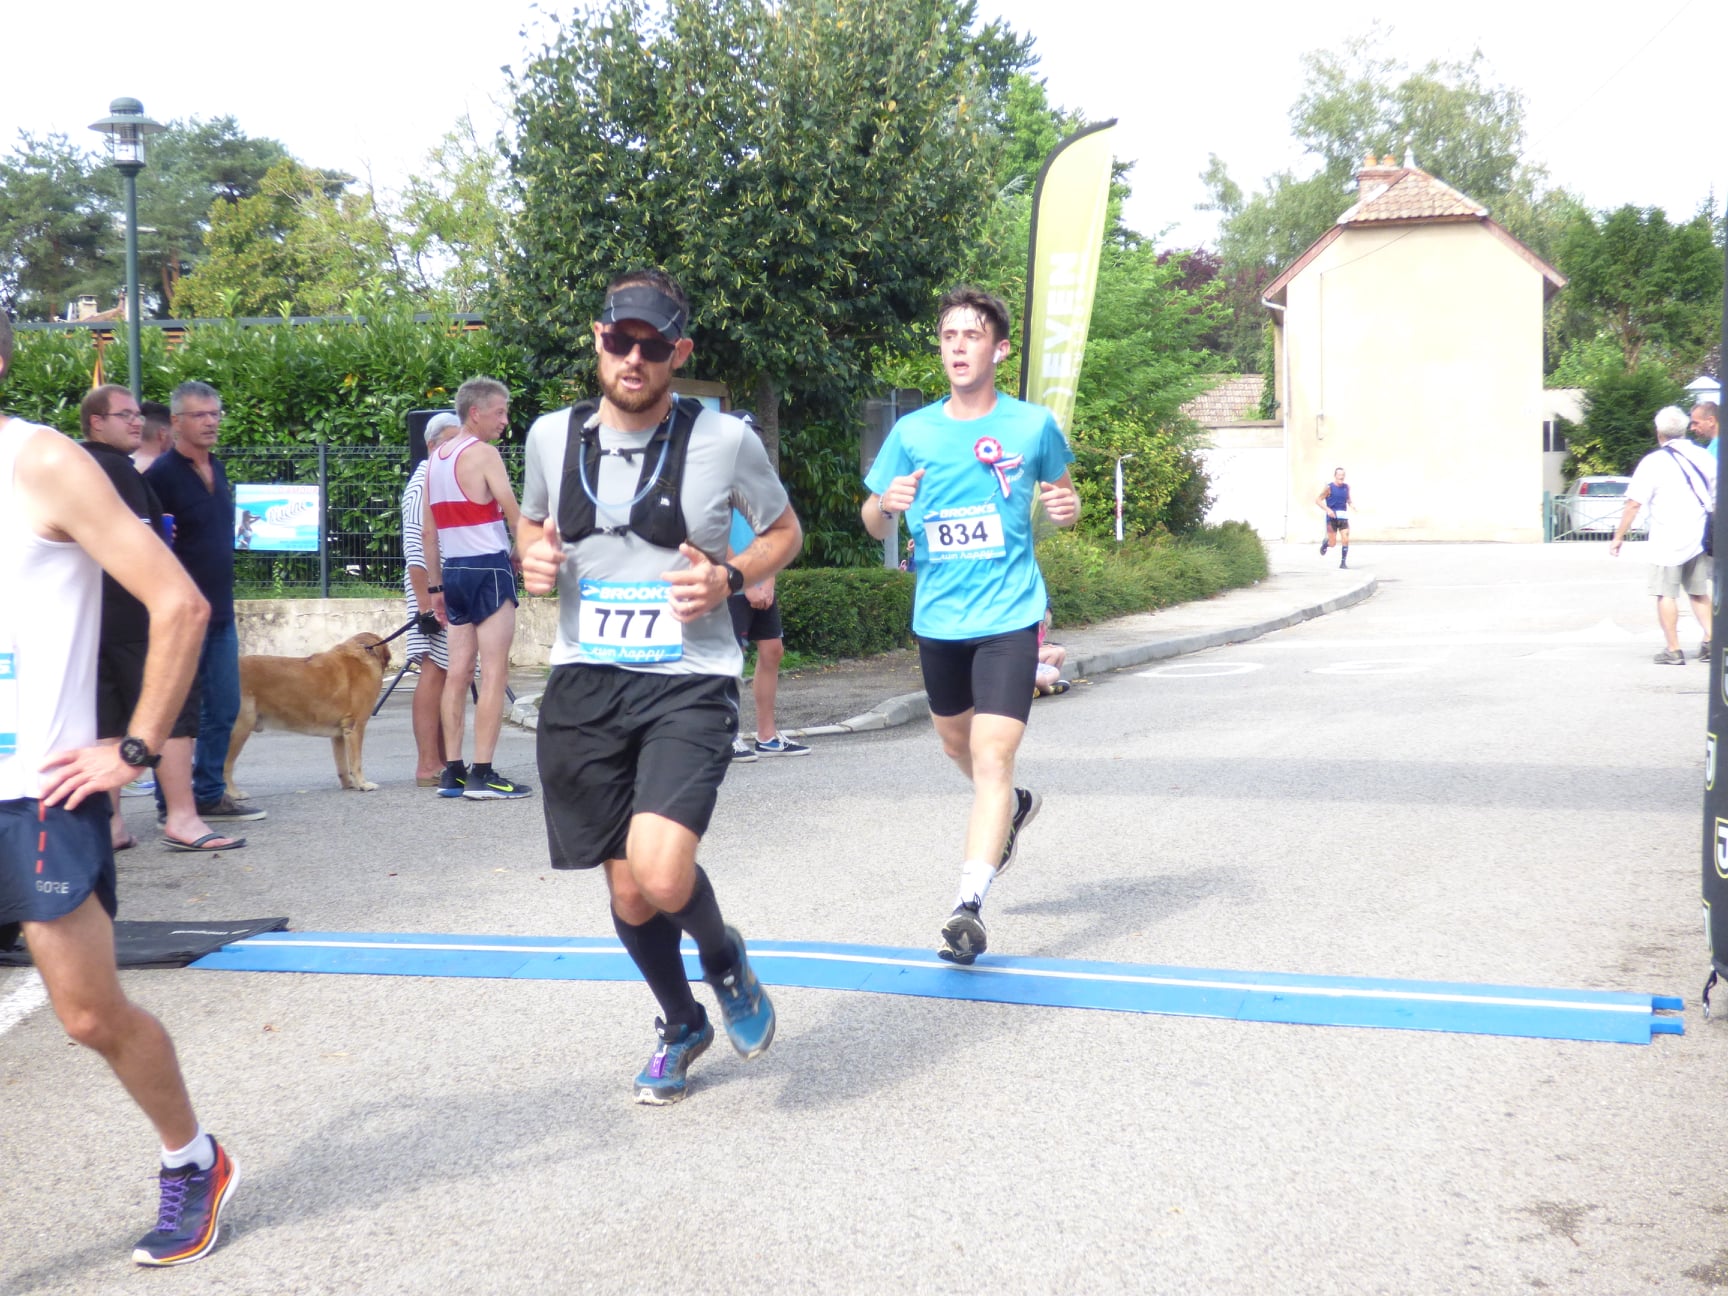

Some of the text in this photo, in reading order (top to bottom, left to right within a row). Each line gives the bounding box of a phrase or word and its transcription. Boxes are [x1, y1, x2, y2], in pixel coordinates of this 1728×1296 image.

[940, 503, 996, 518] BROOKS
[939, 521, 988, 546] 834
[594, 607, 661, 638] 777
[35, 880, 70, 894] GORE
